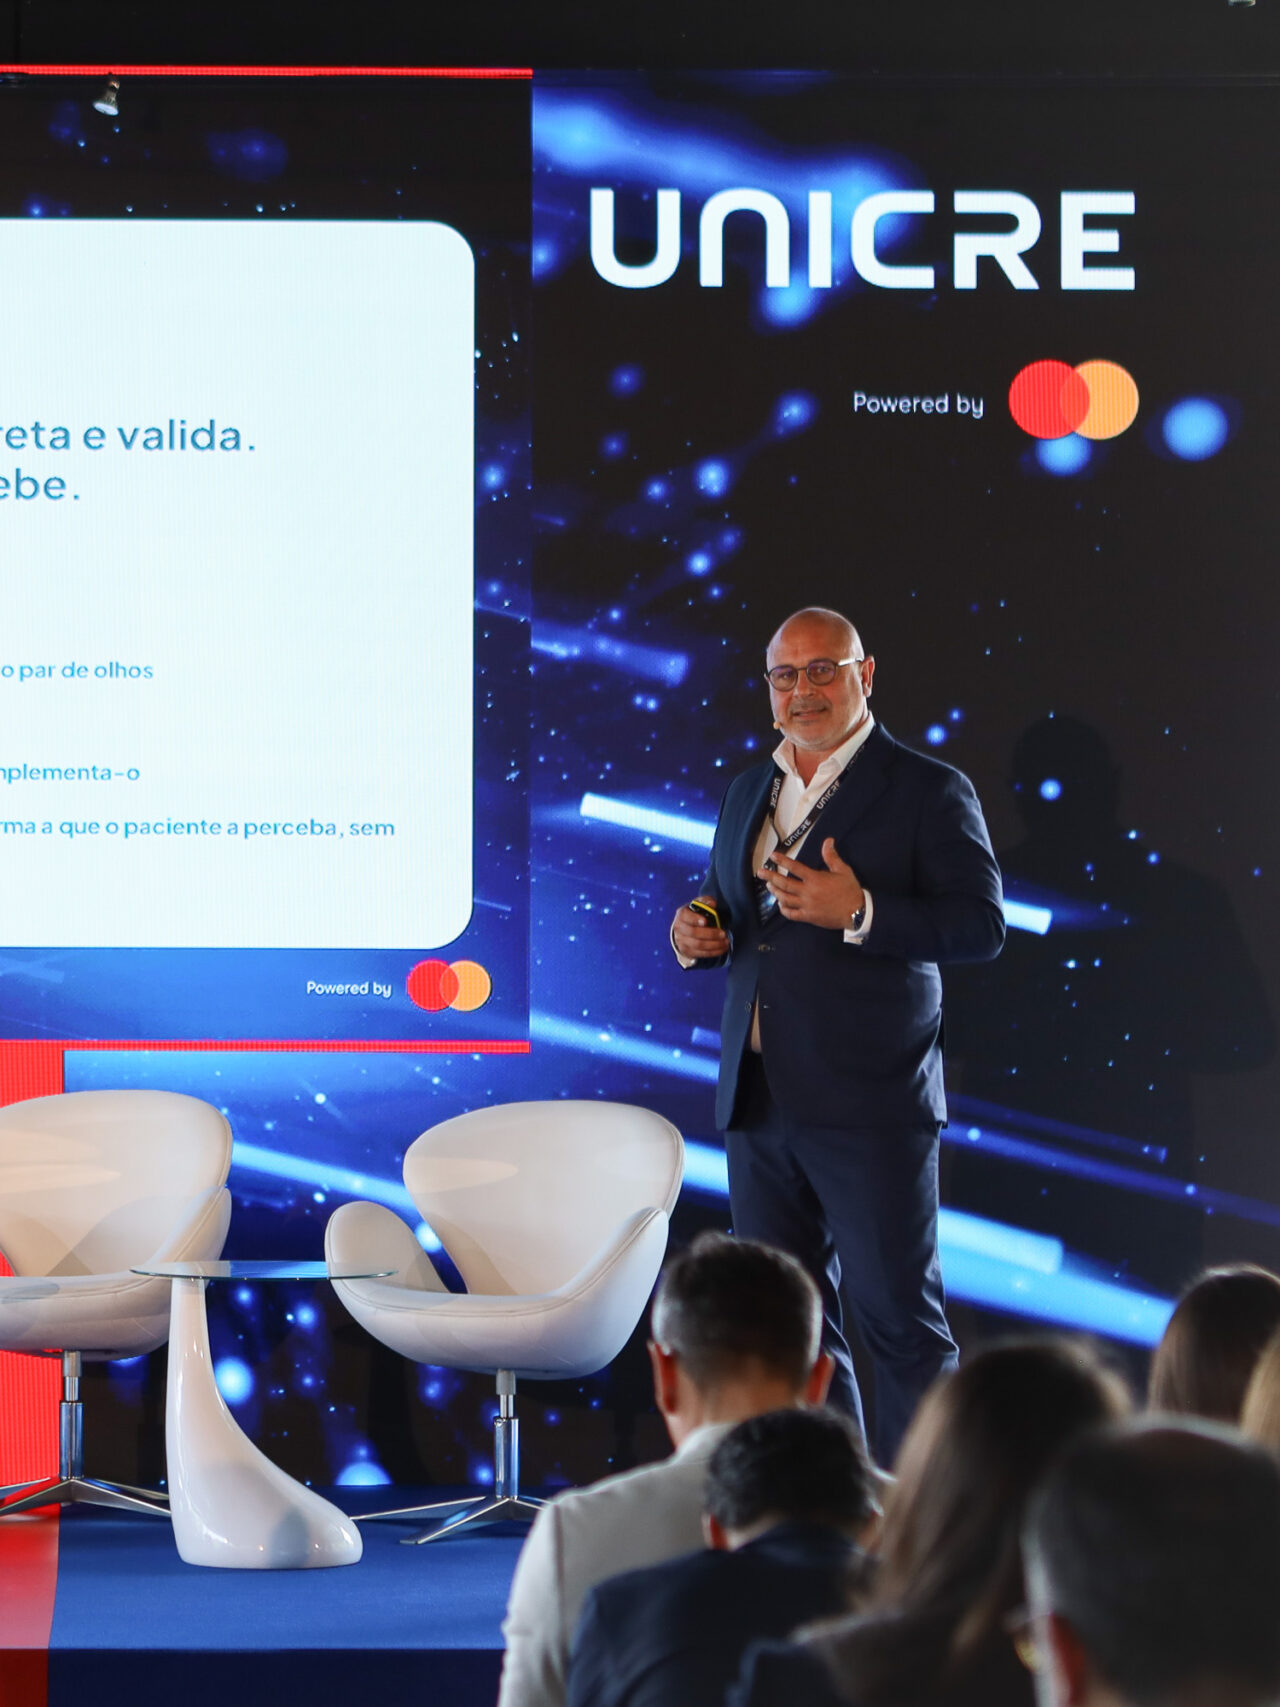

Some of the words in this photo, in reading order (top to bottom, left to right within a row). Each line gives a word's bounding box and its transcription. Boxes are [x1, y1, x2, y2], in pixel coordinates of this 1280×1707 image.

[590, 187, 1136, 291] UNICRE
[852, 391, 949, 415] Powered
[956, 393, 984, 420] by
[82, 425, 107, 451] e
[117, 418, 256, 452] valida.
[18, 664, 56, 683] par
[60, 661, 89, 679] de
[93, 660, 154, 679] olhos
[40, 821, 53, 835] a
[58, 821, 101, 839] que
[104, 821, 120, 835] o
[123, 817, 222, 840] paciente
[226, 822, 239, 835] a
[243, 817, 344, 840] perceba,
[349, 822, 395, 836] sem
[784, 819, 812, 847] UNICRE
[306, 980, 369, 996] Powered
[372, 981, 392, 1000] by
